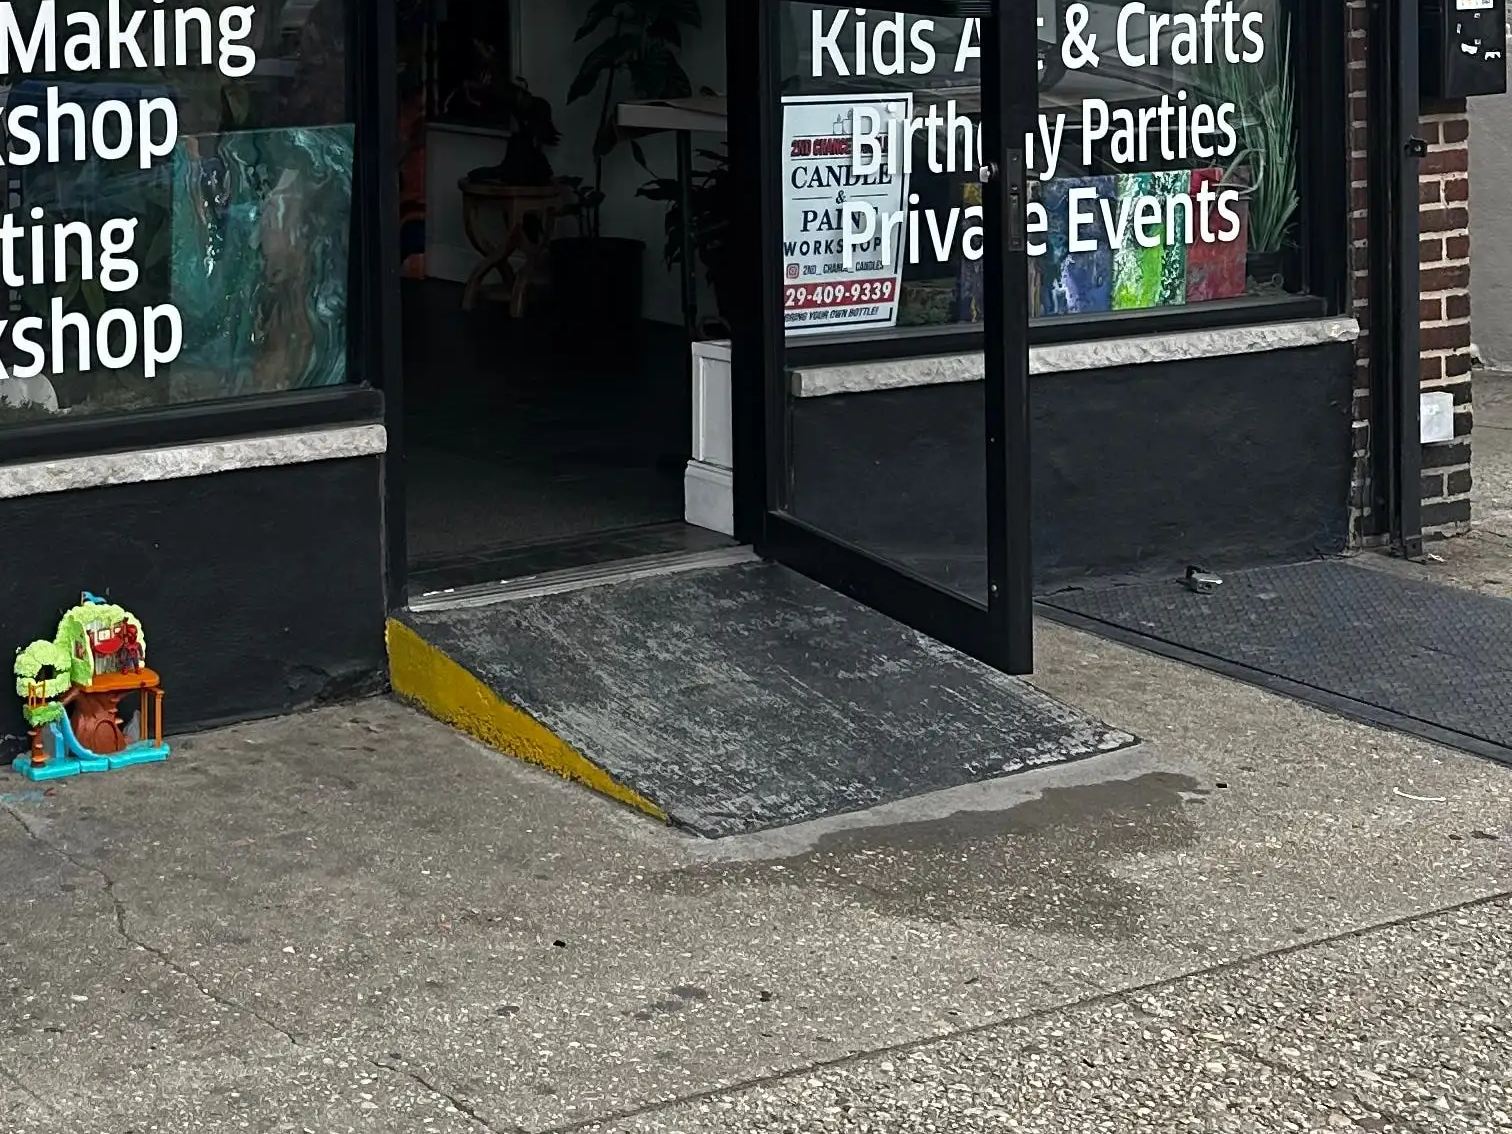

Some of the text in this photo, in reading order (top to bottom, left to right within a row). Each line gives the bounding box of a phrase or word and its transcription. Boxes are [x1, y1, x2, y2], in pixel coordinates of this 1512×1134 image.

[811, 7, 936, 78] Kids
[1061, 2, 1100, 70] &
[851, 90, 1238, 181] Birthy Parties
[800, 207, 879, 233] PAIN
[836, 190, 847, 204] &
[783, 236, 882, 257] WORKSOP
[841, 178, 1241, 268] Privae Events
